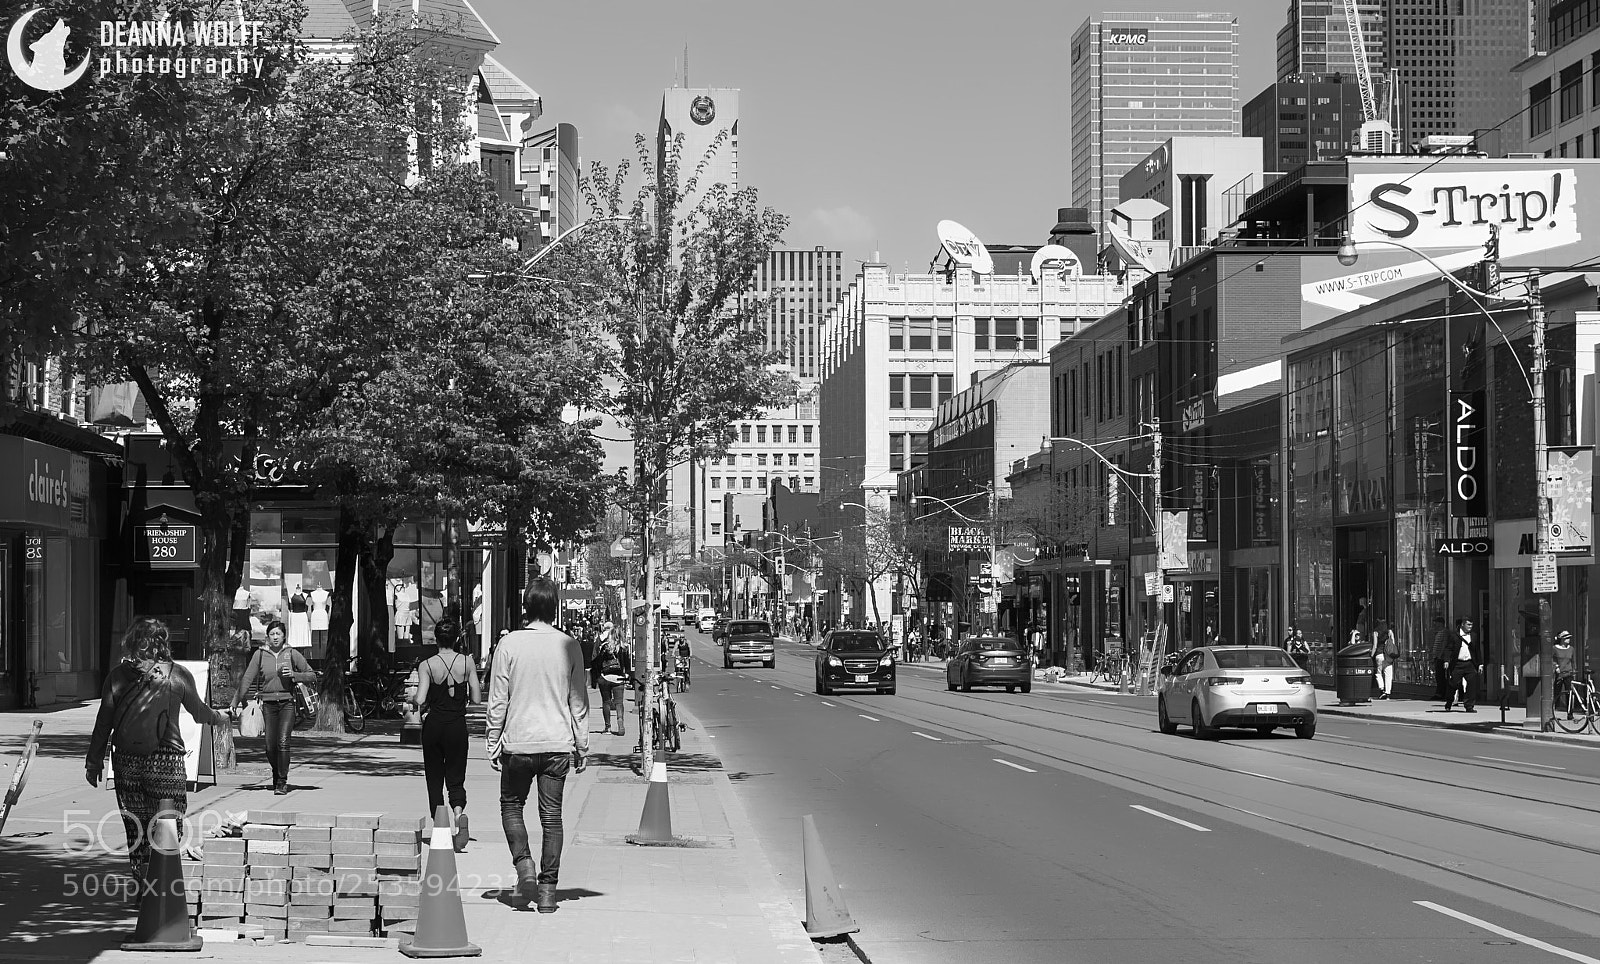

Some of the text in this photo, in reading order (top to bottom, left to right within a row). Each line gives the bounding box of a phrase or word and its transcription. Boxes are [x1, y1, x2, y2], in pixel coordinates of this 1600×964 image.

[1109, 34, 1147, 45] KPMG
[1367, 173, 1562, 239] S-Trip!
[1456, 398, 1477, 501] ALDO
[29, 459, 67, 508] claire's
[1192, 469, 1203, 538] Foot Locker
[950, 527, 985, 535] BLACK
[152, 545, 177, 559] 280
[1438, 543, 1489, 554] ALDO
